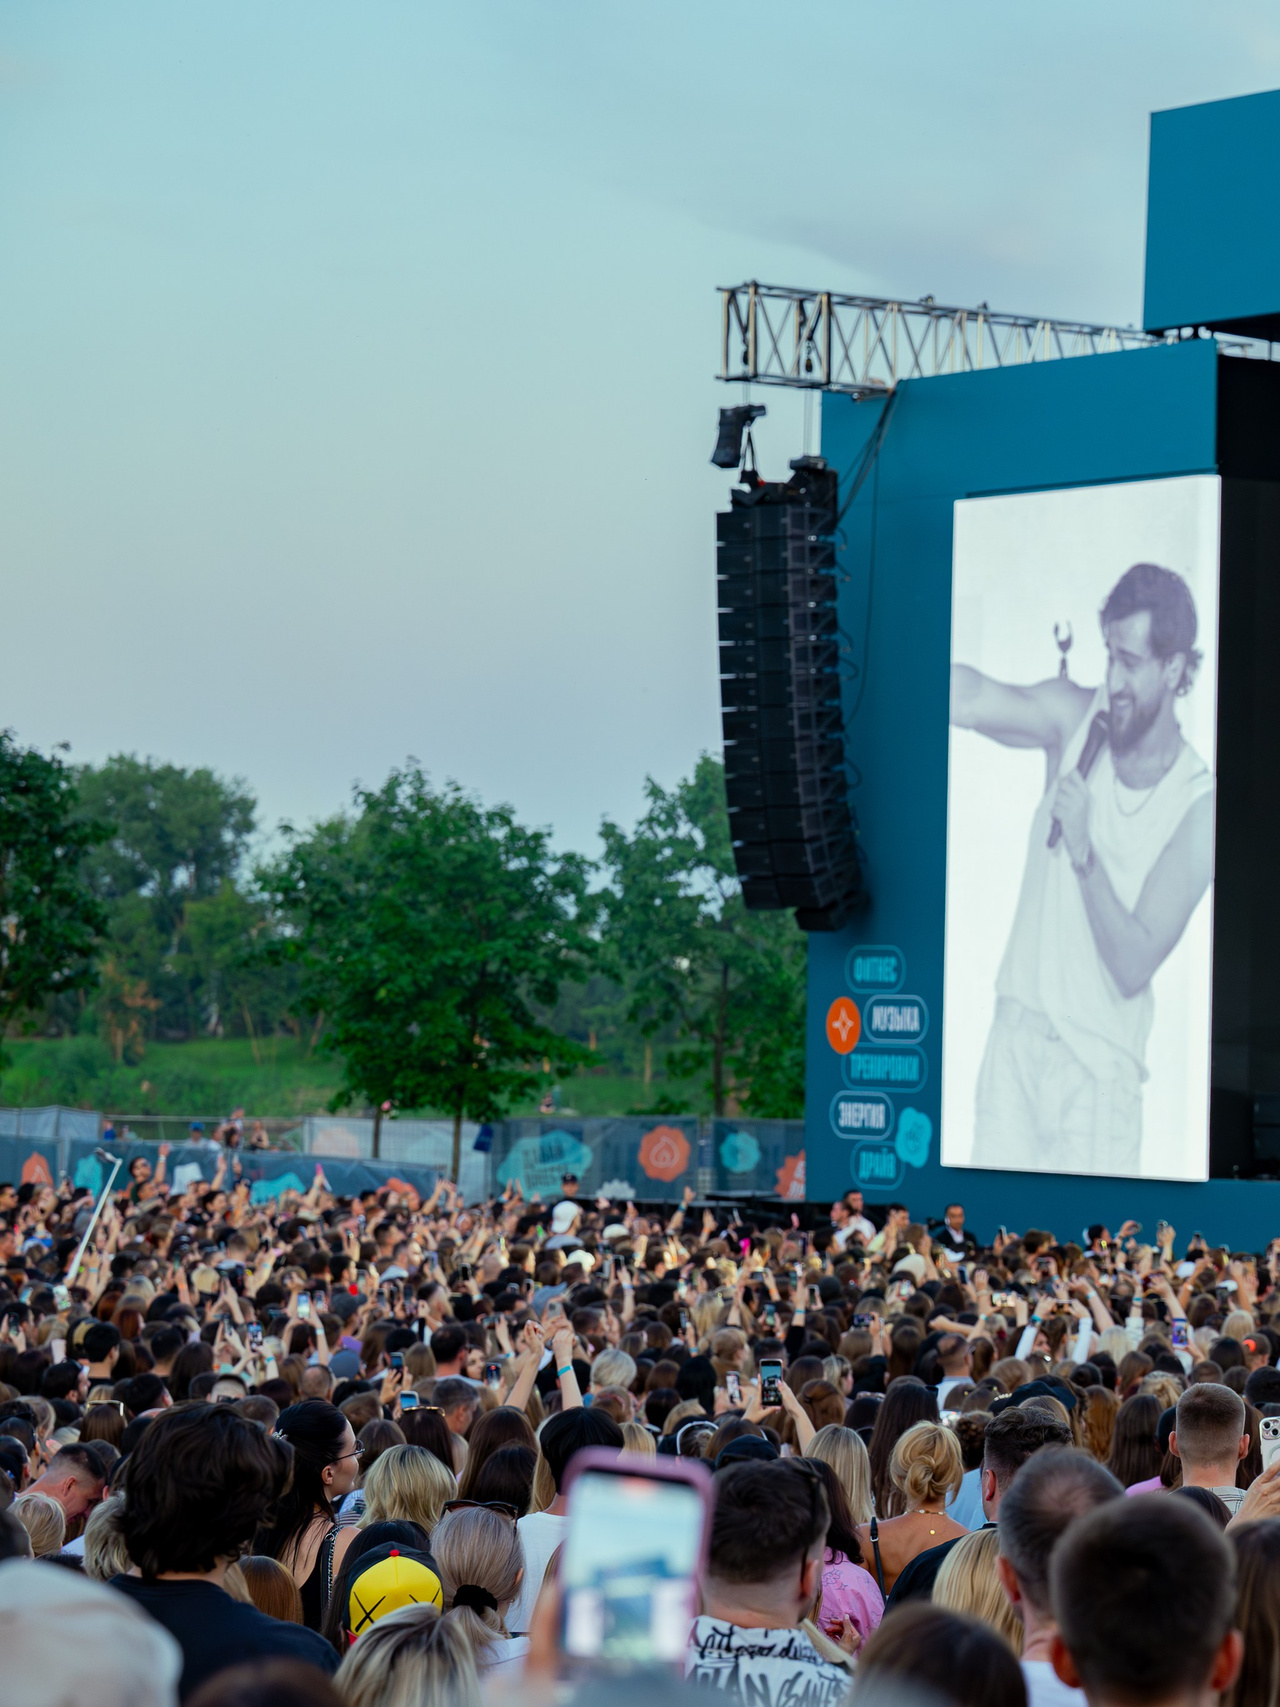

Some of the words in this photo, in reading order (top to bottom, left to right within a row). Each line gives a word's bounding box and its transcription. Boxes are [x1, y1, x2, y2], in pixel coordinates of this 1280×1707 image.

[853, 956, 898, 983] ФИТНЕС
[871, 1005, 920, 1032] МУЗЫКА
[850, 1053, 920, 1081] ТРЕНИРОВКИ
[838, 1101, 886, 1129] ЭНЕРГИЯ
[858, 1146, 896, 1181] ДРАЙВ
